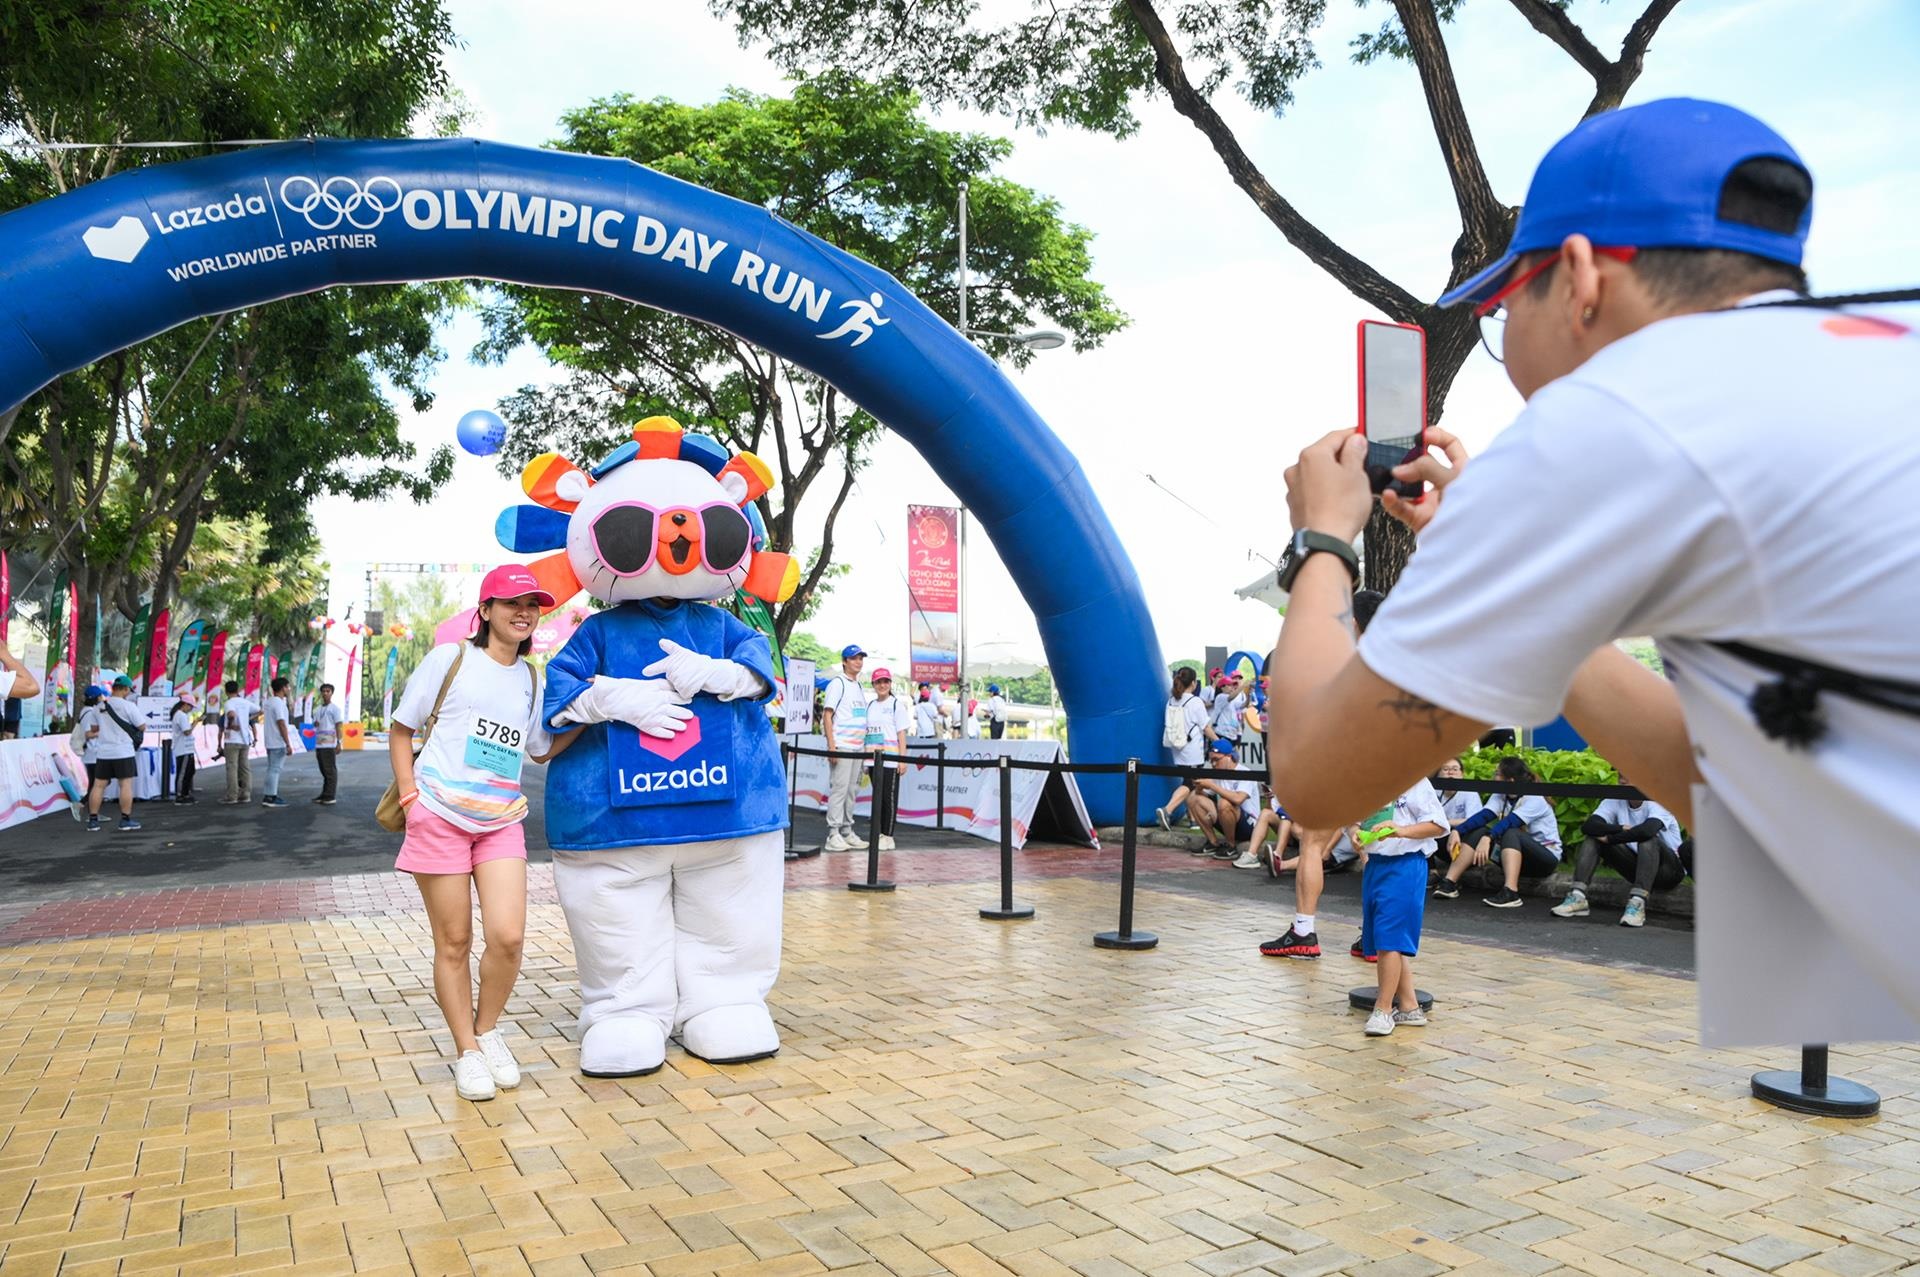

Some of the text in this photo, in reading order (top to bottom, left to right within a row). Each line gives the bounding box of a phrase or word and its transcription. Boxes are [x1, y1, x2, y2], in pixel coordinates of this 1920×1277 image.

[151, 192, 267, 236] Lazada
[167, 233, 377, 283] WORLDWIDE PARTNER
[402, 188, 832, 323] OLYMPIC DAY RUN
[792, 683, 810, 702] 10KM
[472, 738, 497, 751] OLYMPIC
[496, 746, 508, 754] DAY
[475, 717, 521, 748] 5789
[618, 760, 728, 795] Lazada
